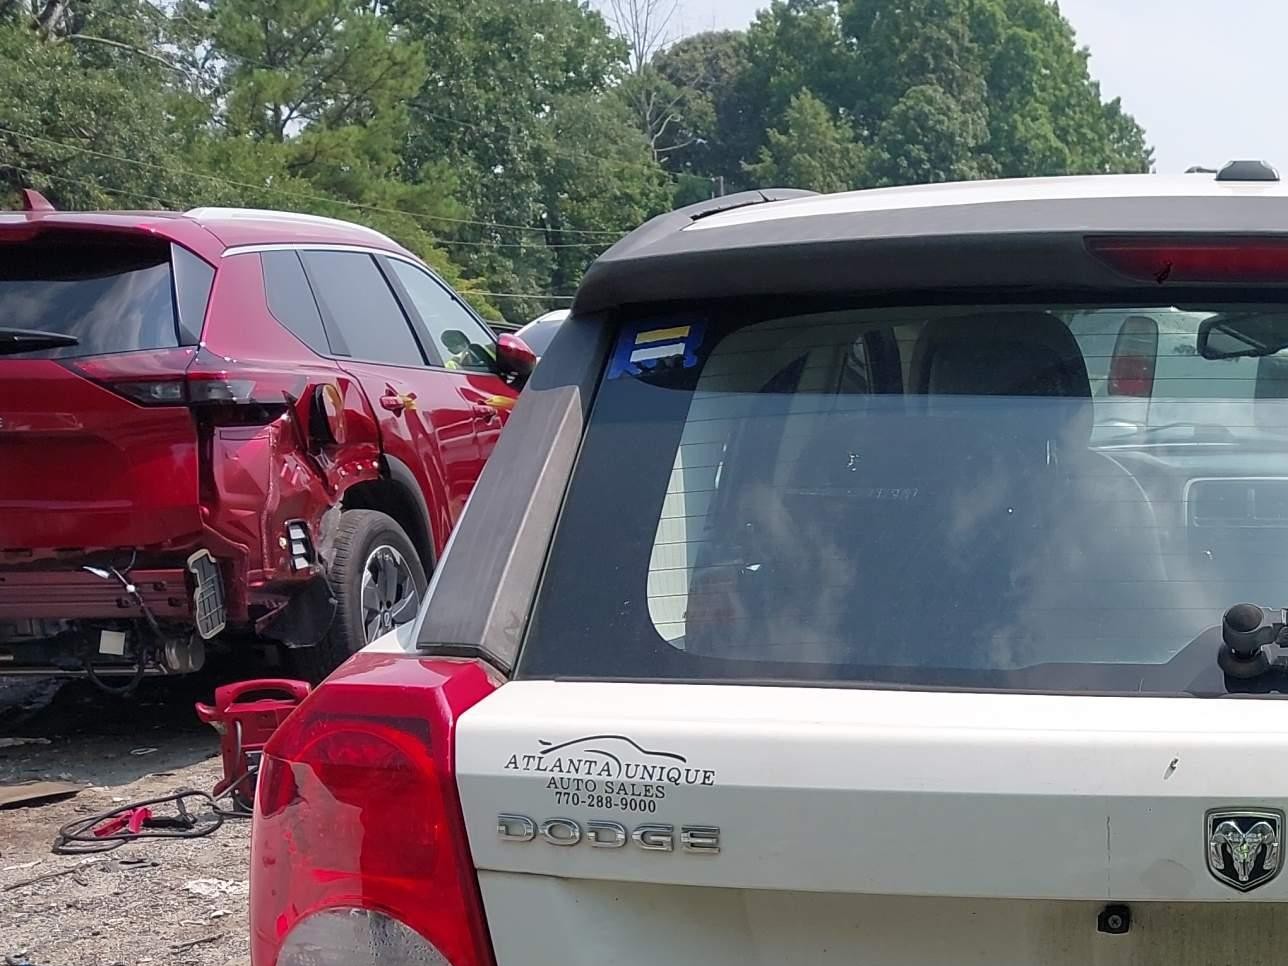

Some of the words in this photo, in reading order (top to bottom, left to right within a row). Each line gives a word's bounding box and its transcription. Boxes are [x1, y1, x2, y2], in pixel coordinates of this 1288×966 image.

[503, 754, 613, 777] ATLANTA
[624, 763, 716, 786] UNIQUE
[546, 776, 597, 792] AUTO
[604, 781, 666, 799] SALES
[554, 791, 657, 813] 770-288-9000
[497, 813, 721, 853] DODGE
